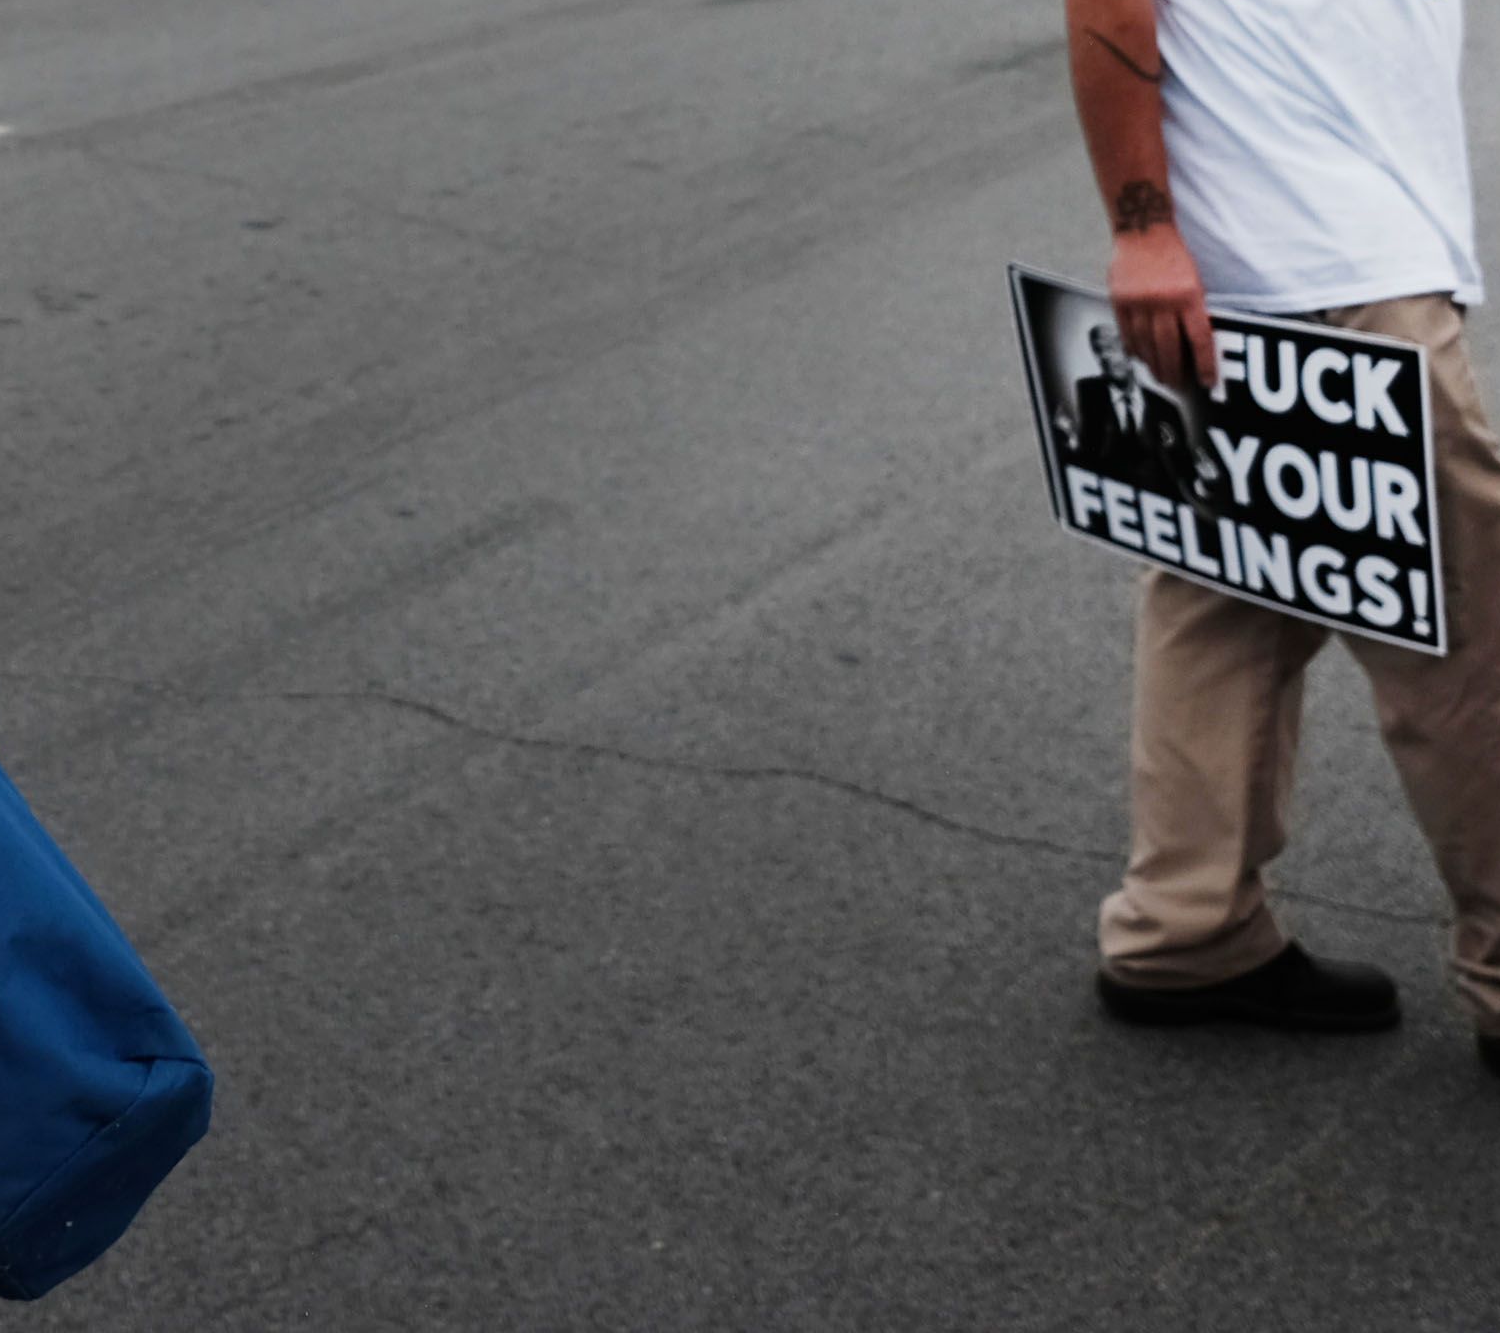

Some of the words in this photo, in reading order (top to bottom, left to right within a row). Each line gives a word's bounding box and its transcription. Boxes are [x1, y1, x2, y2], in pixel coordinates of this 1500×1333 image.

[1210, 329, 1409, 437] FUCK
[1208, 427, 1427, 547] YOUR
[1065, 465, 1432, 636] FEELINGS!
